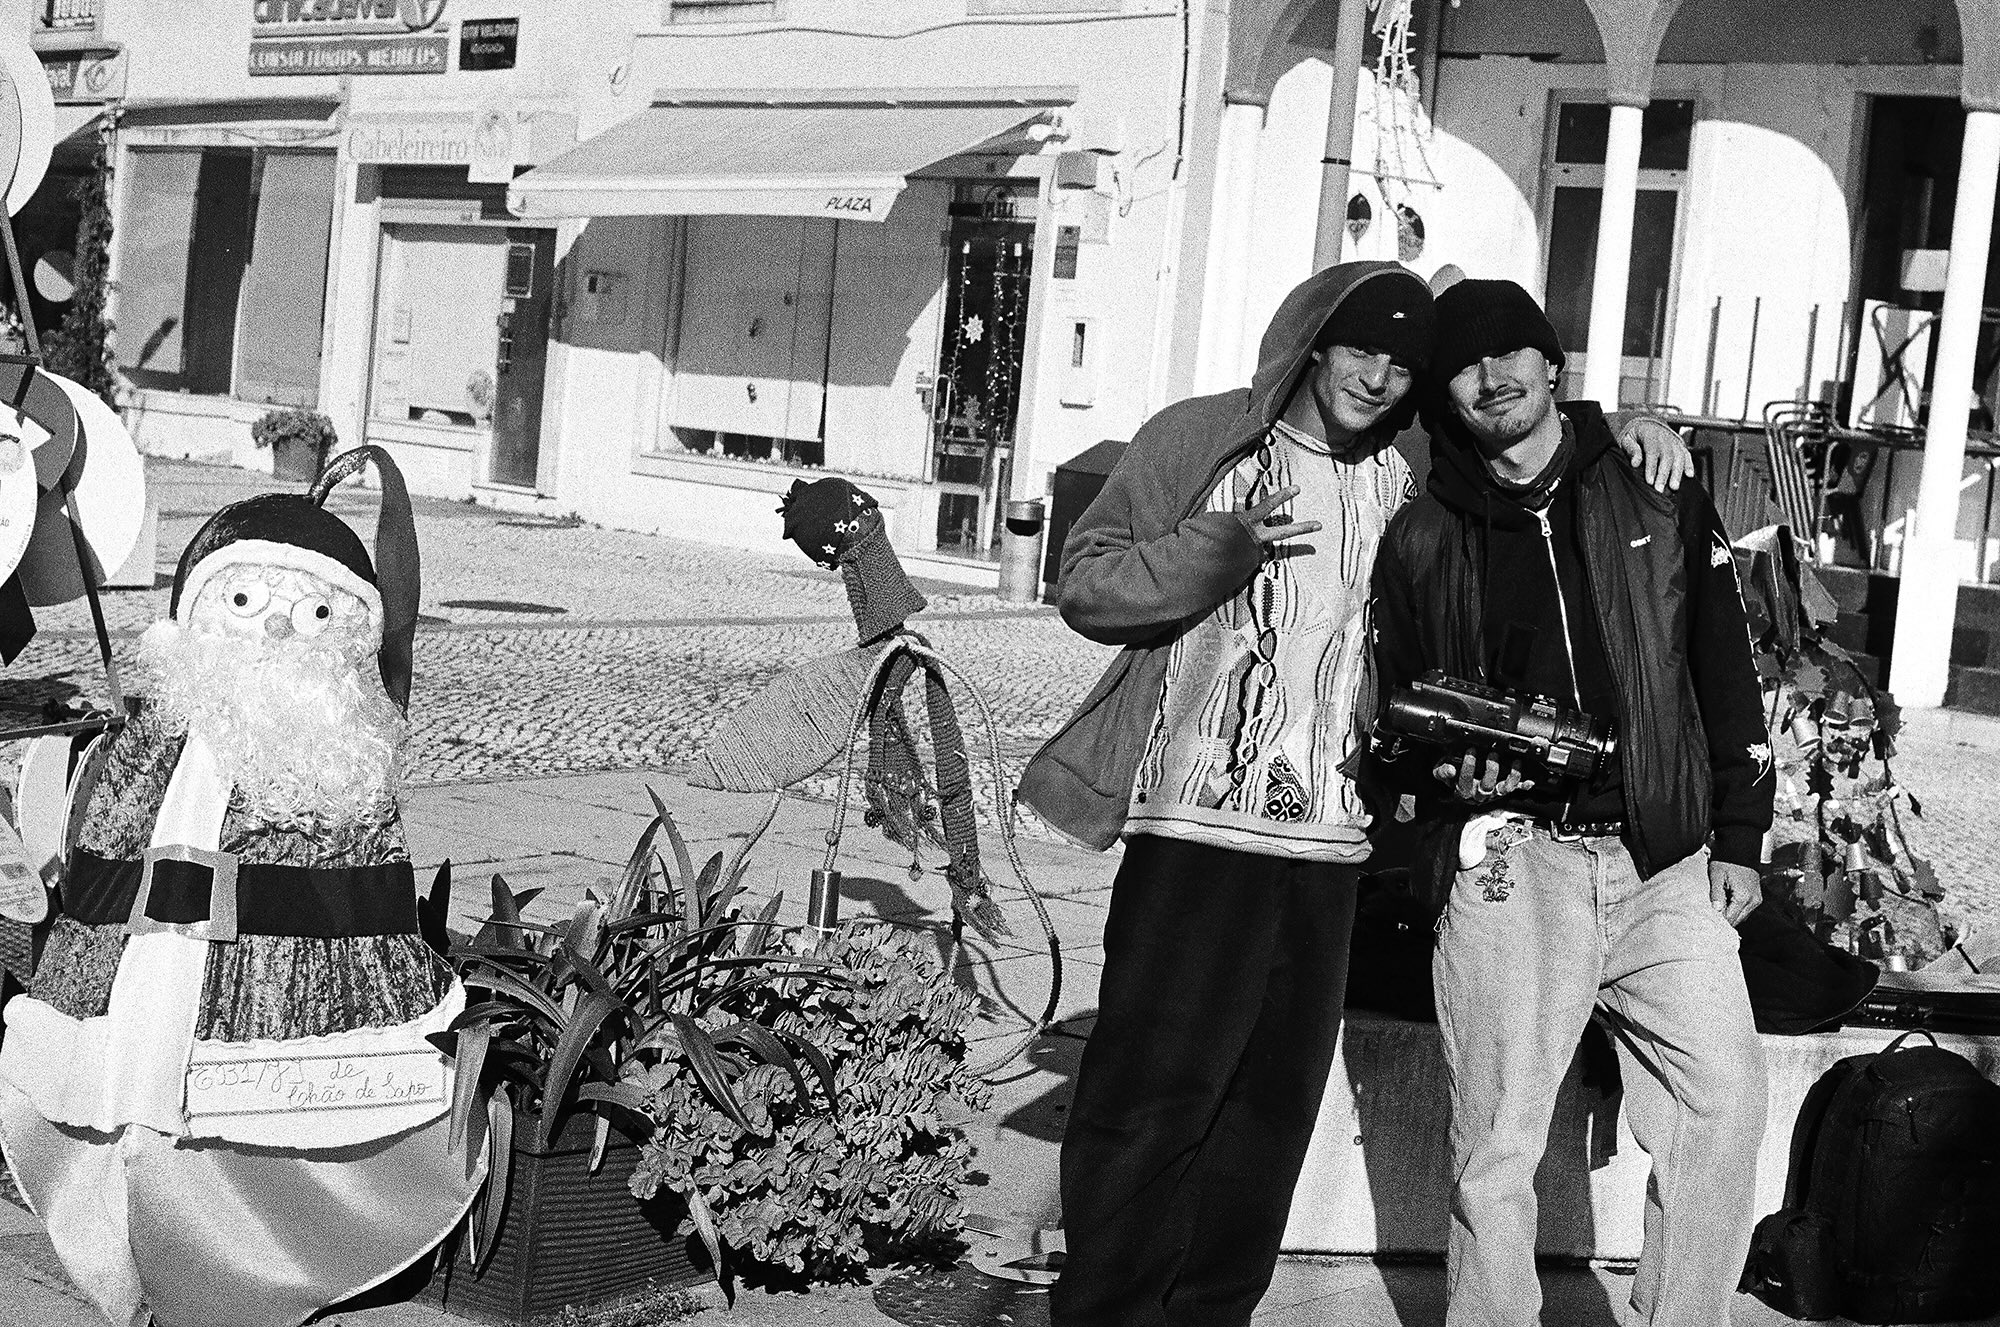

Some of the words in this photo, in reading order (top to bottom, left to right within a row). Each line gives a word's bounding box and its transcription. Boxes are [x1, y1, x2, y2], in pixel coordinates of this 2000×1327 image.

[347, 127, 469, 160] Cabeleireiro
[826, 197, 872, 213] PLAZA
[330, 1061, 365, 1080] de
[356, 1077, 375, 1100] de
[382, 1071, 432, 1100] Sapo
